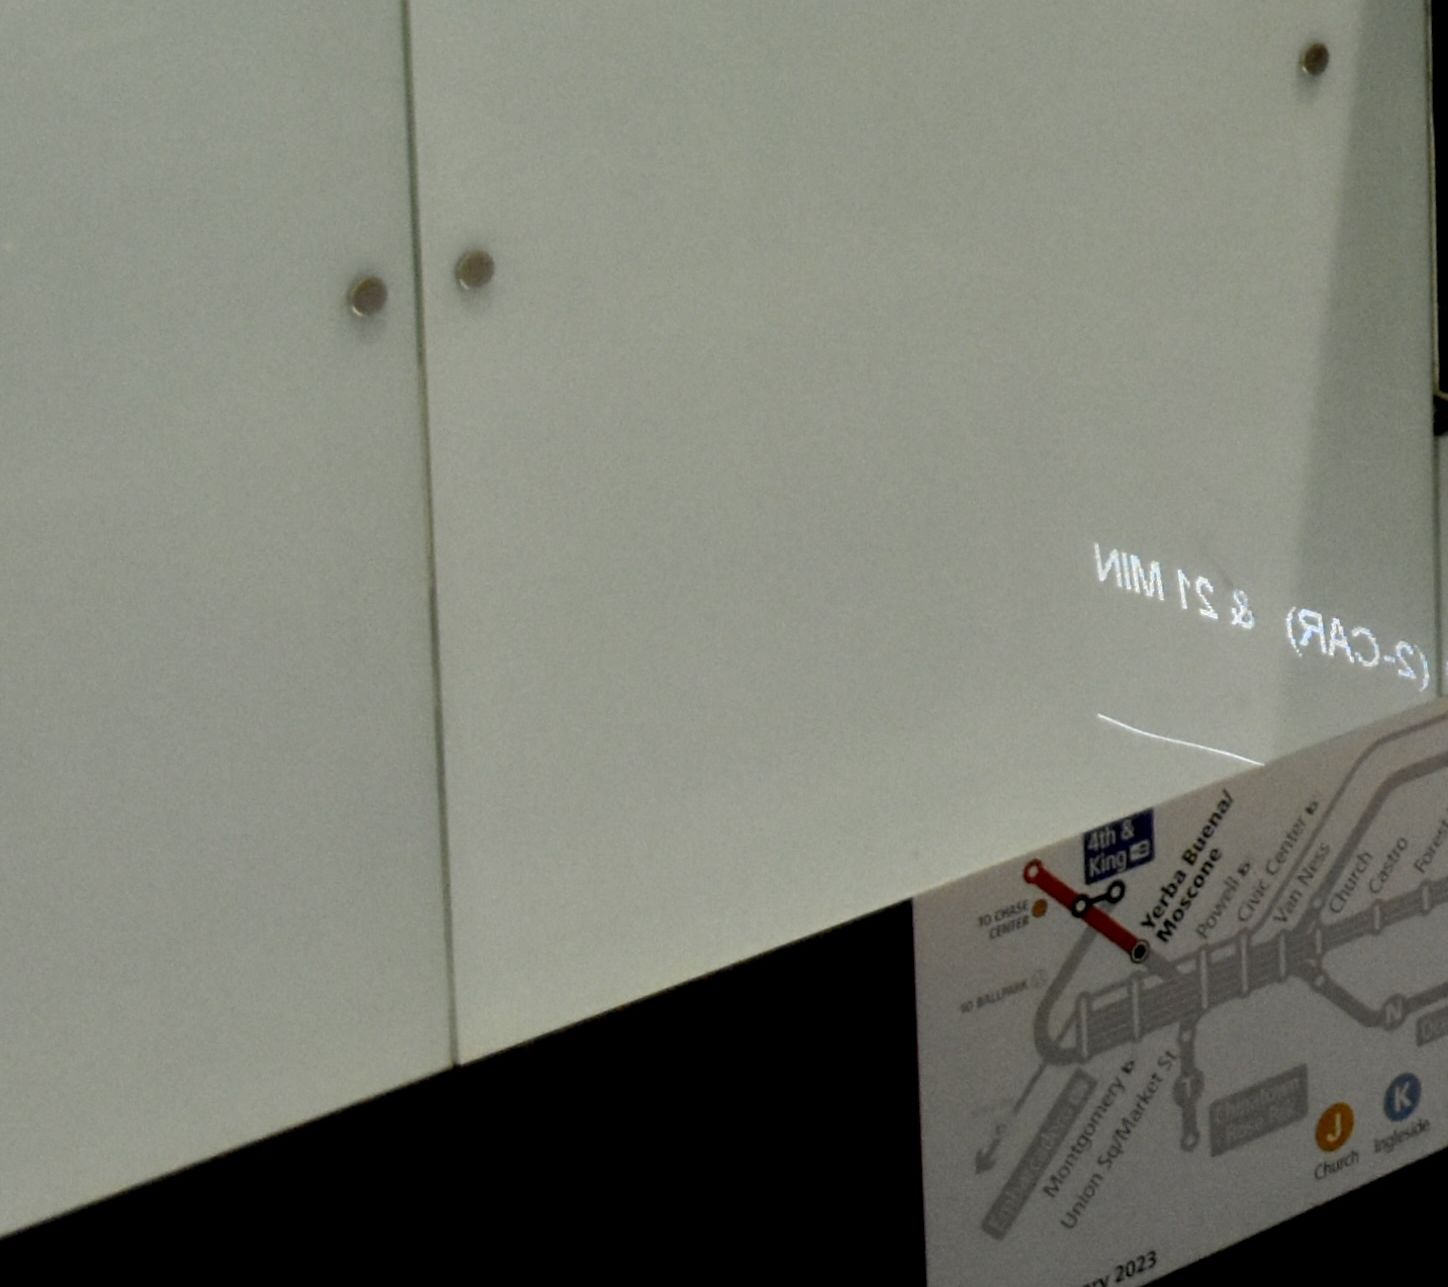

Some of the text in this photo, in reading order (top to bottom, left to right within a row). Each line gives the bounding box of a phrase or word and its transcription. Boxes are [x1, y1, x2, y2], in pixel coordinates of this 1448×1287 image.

[1087, 818, 1135, 852] 4th &
[1088, 849, 1128, 877] King
[1140, 788, 1234, 929] Yerba Buena/
[1368, 837, 1409, 894] Castro
[1156, 847, 1223, 943] Moscone
[1237, 816, 1306, 923] Civic Center
[1273, 841, 1331, 924] Van Ness
[1329, 850, 1373, 914] Church
[1195, 875, 1240, 939] Powell
[1042, 1076, 1126, 1198] Montgomery
[1060, 1172, 1104, 1231] Union
[1097, 1071, 1164, 1170] Sq/Market
[1314, 1149, 1360, 1180] Church
[1114, 1250, 1158, 1284] 2023
